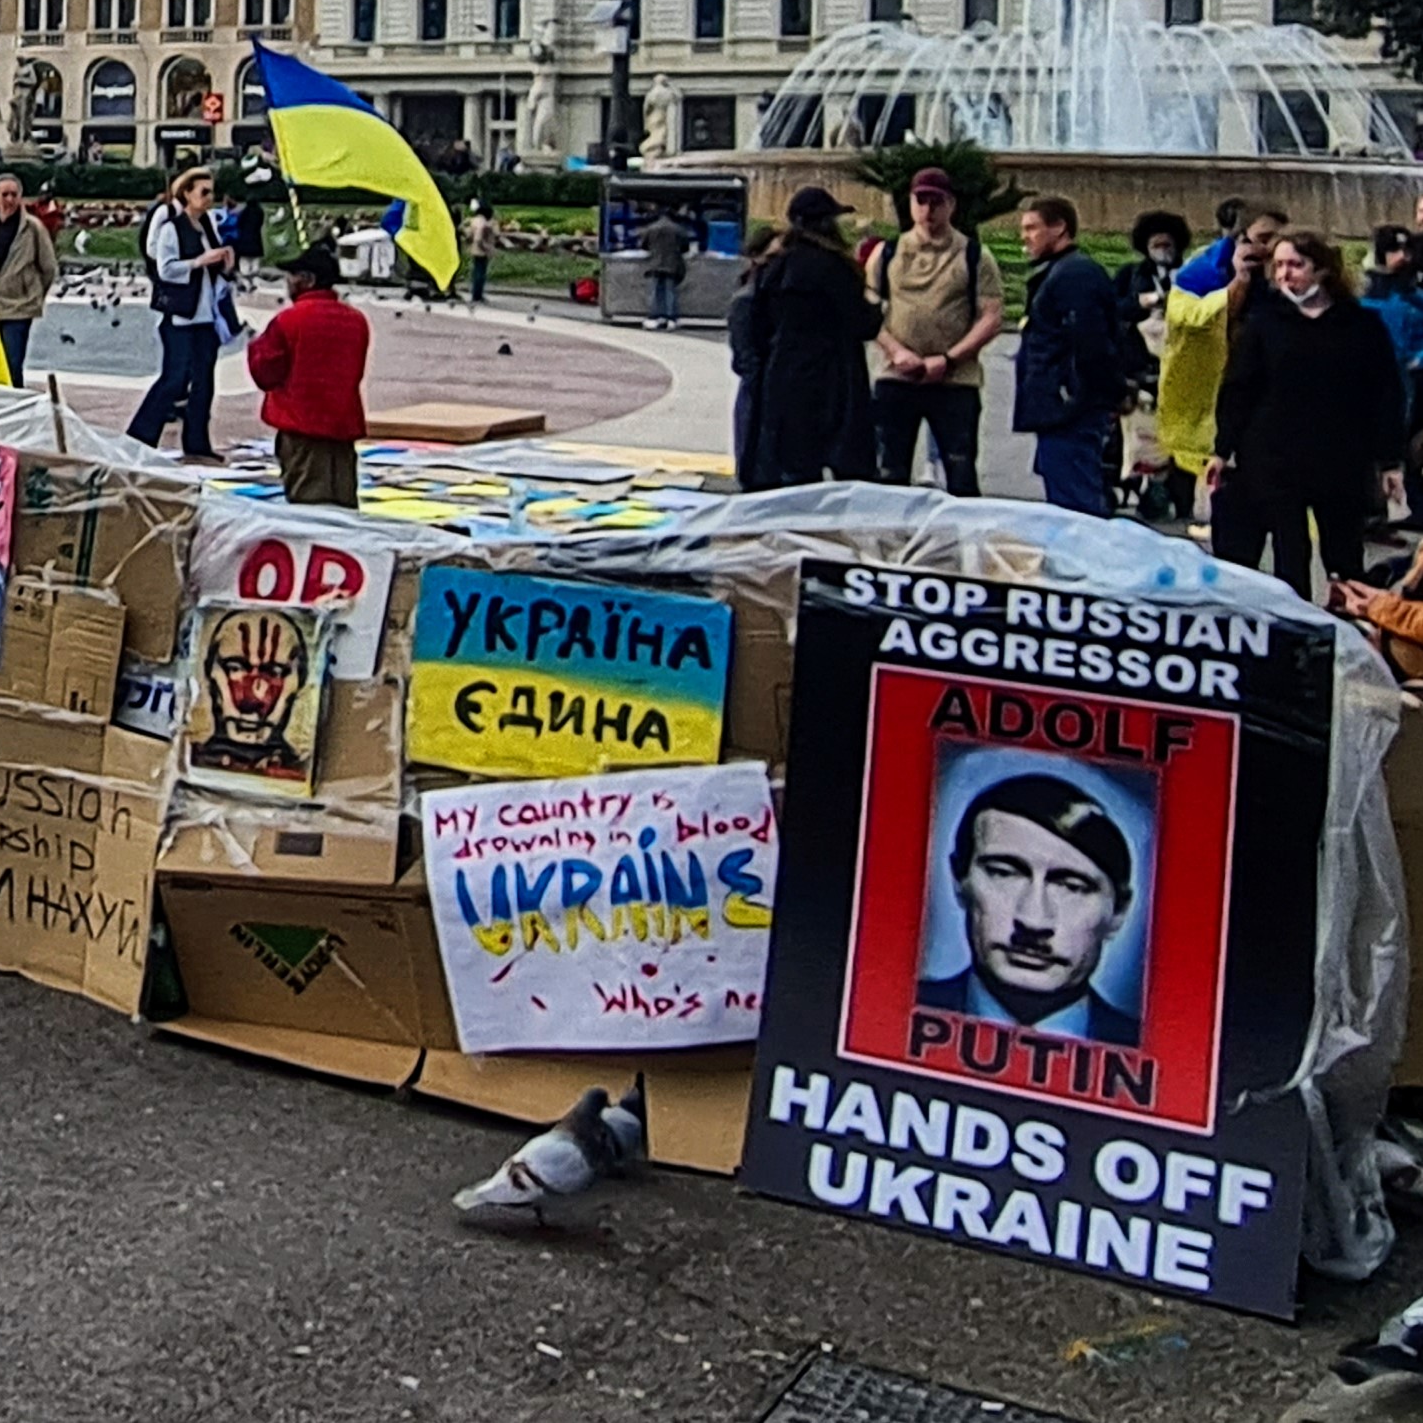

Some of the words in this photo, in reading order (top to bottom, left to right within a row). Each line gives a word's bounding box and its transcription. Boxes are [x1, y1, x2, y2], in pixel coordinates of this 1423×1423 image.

[443, 586, 715, 671] УКРАЇНА
[843, 568, 988, 619] STOP
[1005, 587, 1271, 656] RUSSIAN
[878, 618, 1242, 700] AGGRESSOR
[453, 680, 671, 752] ЄДИНА
[929, 683, 1195, 765] ADOLF
[908, 1010, 1158, 1108] PUTIN
[767, 1065, 1066, 1182] HANDS
[1095, 1138, 1273, 1226] OFF
[806, 1144, 1214, 1292] UKRAINE
